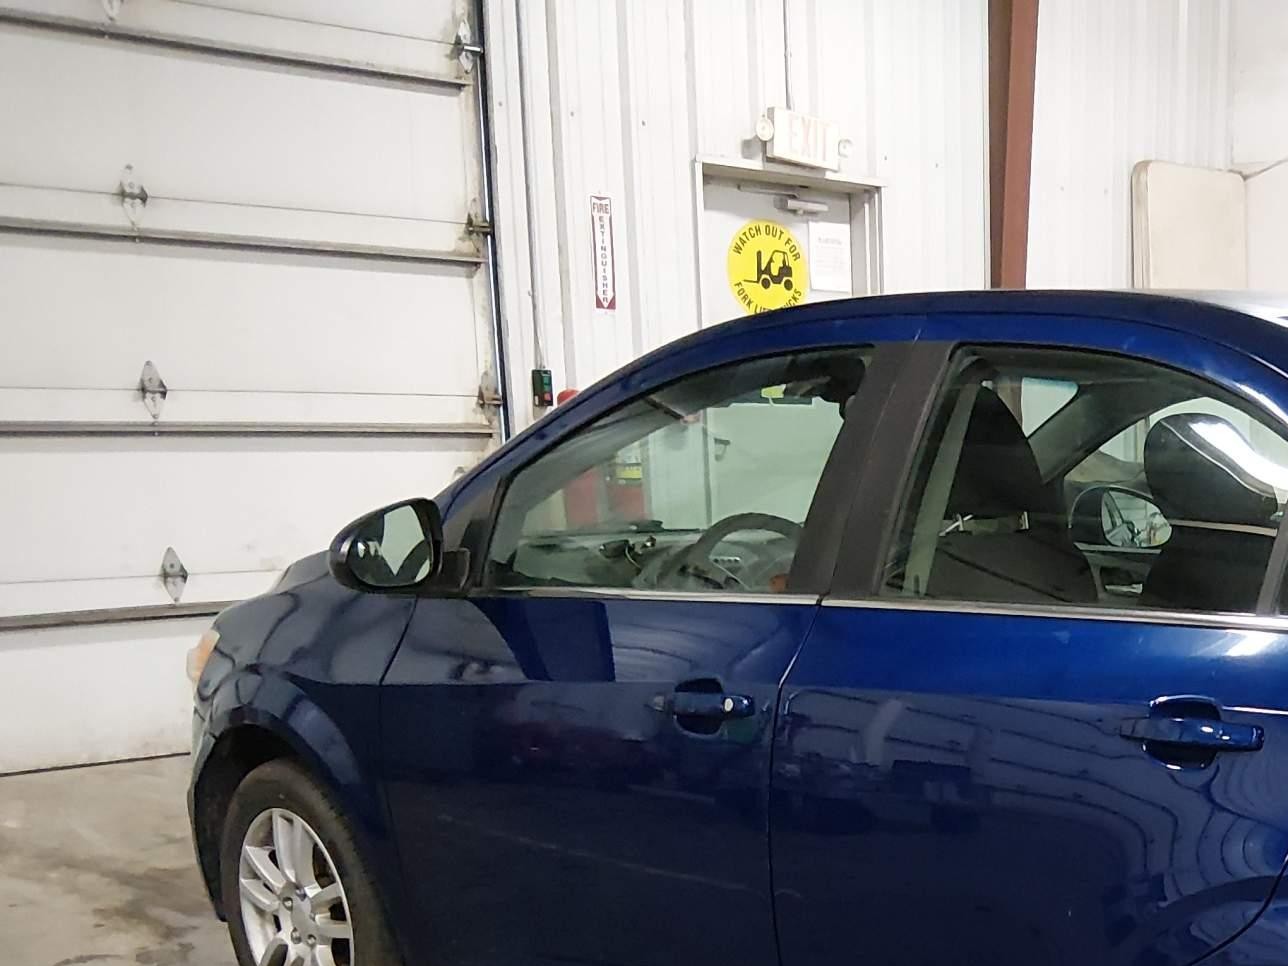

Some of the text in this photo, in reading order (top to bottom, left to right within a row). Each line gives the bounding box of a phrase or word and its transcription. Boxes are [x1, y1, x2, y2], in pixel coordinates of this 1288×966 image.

[788, 113, 831, 161] EXIT
[592, 202, 610, 214] FIRE
[598, 215, 608, 303] EXTINGUISHER
[733, 224, 762, 255] WATCH
[764, 224, 785, 241] OUT
[784, 237, 801, 262] FOR
[734, 281, 754, 309] FORK
